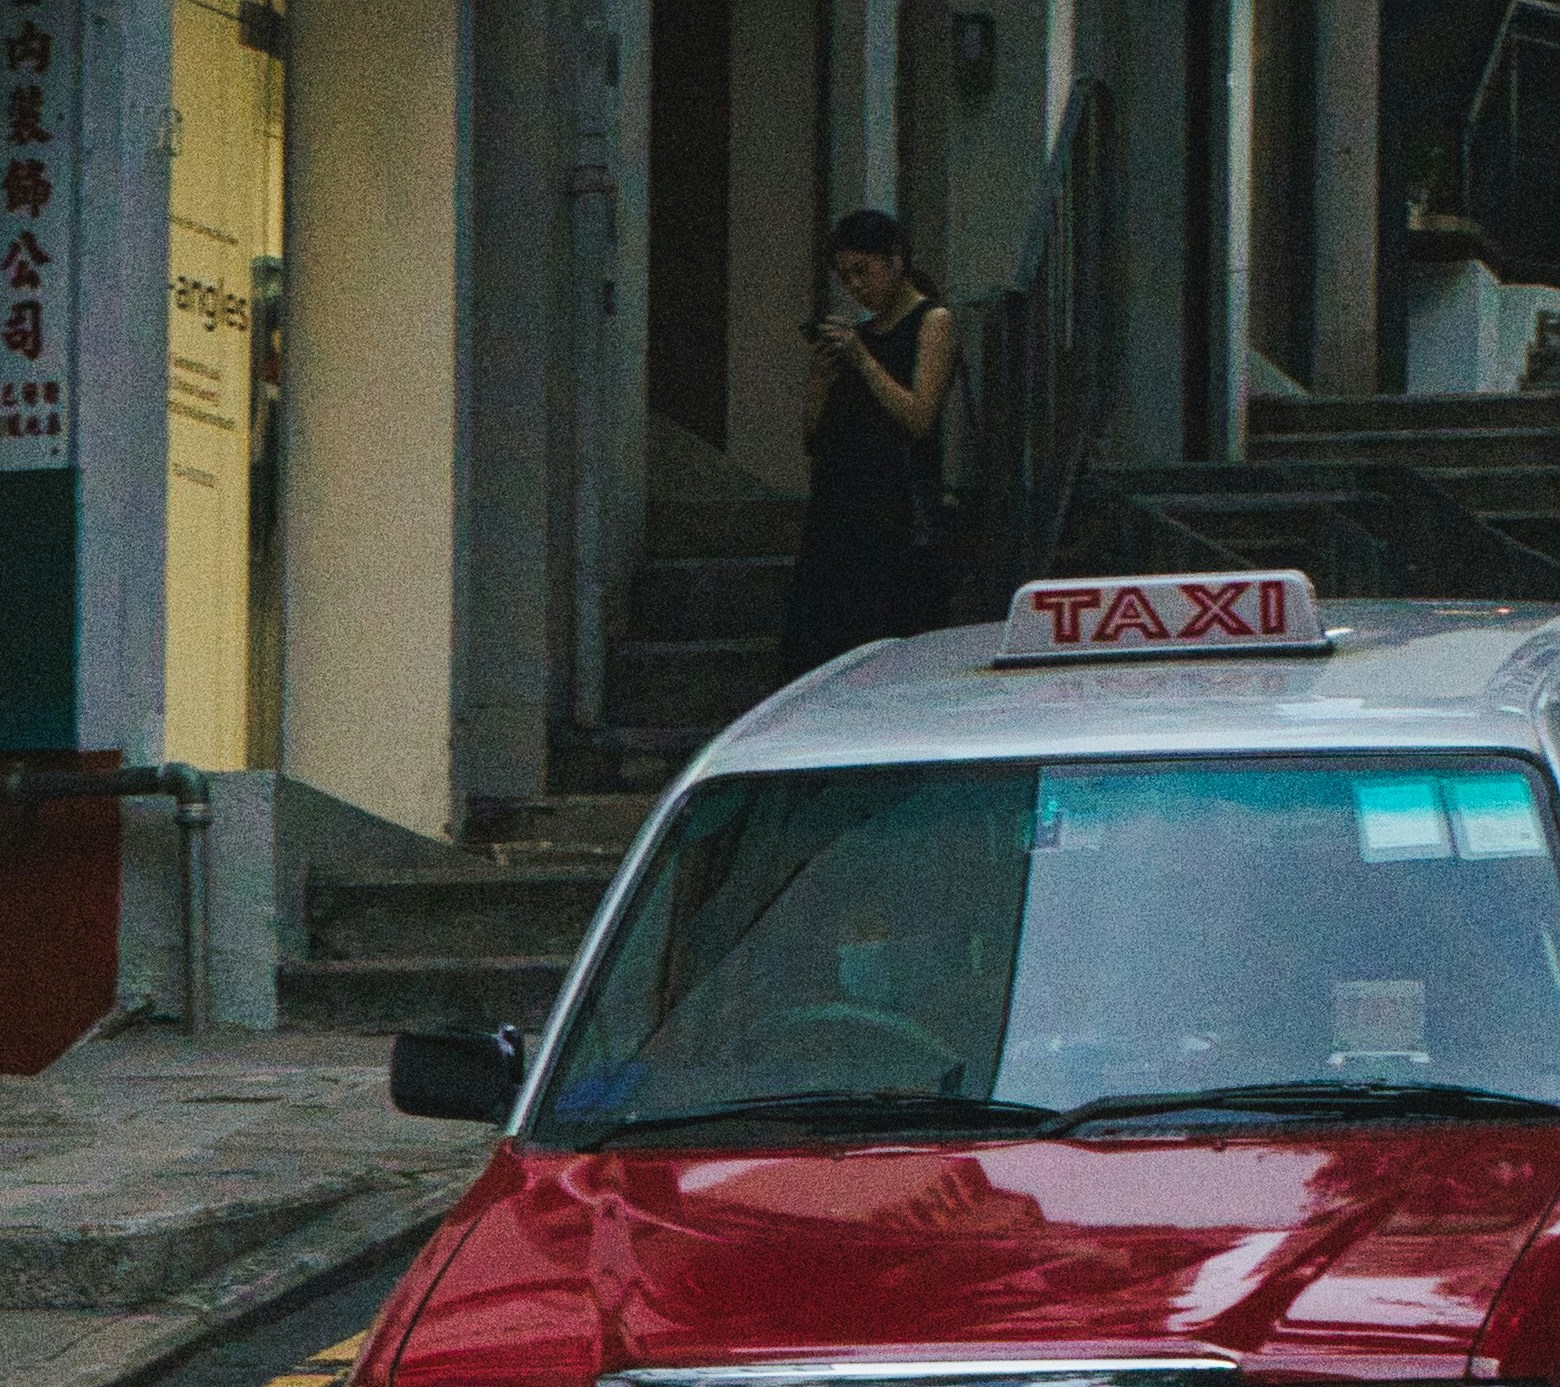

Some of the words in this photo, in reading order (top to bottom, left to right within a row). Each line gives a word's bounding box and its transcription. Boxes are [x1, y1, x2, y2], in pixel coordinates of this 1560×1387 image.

[1, 0, 53, 359] 內裝飾公司
[1032, 579, 1288, 645] TAXI
